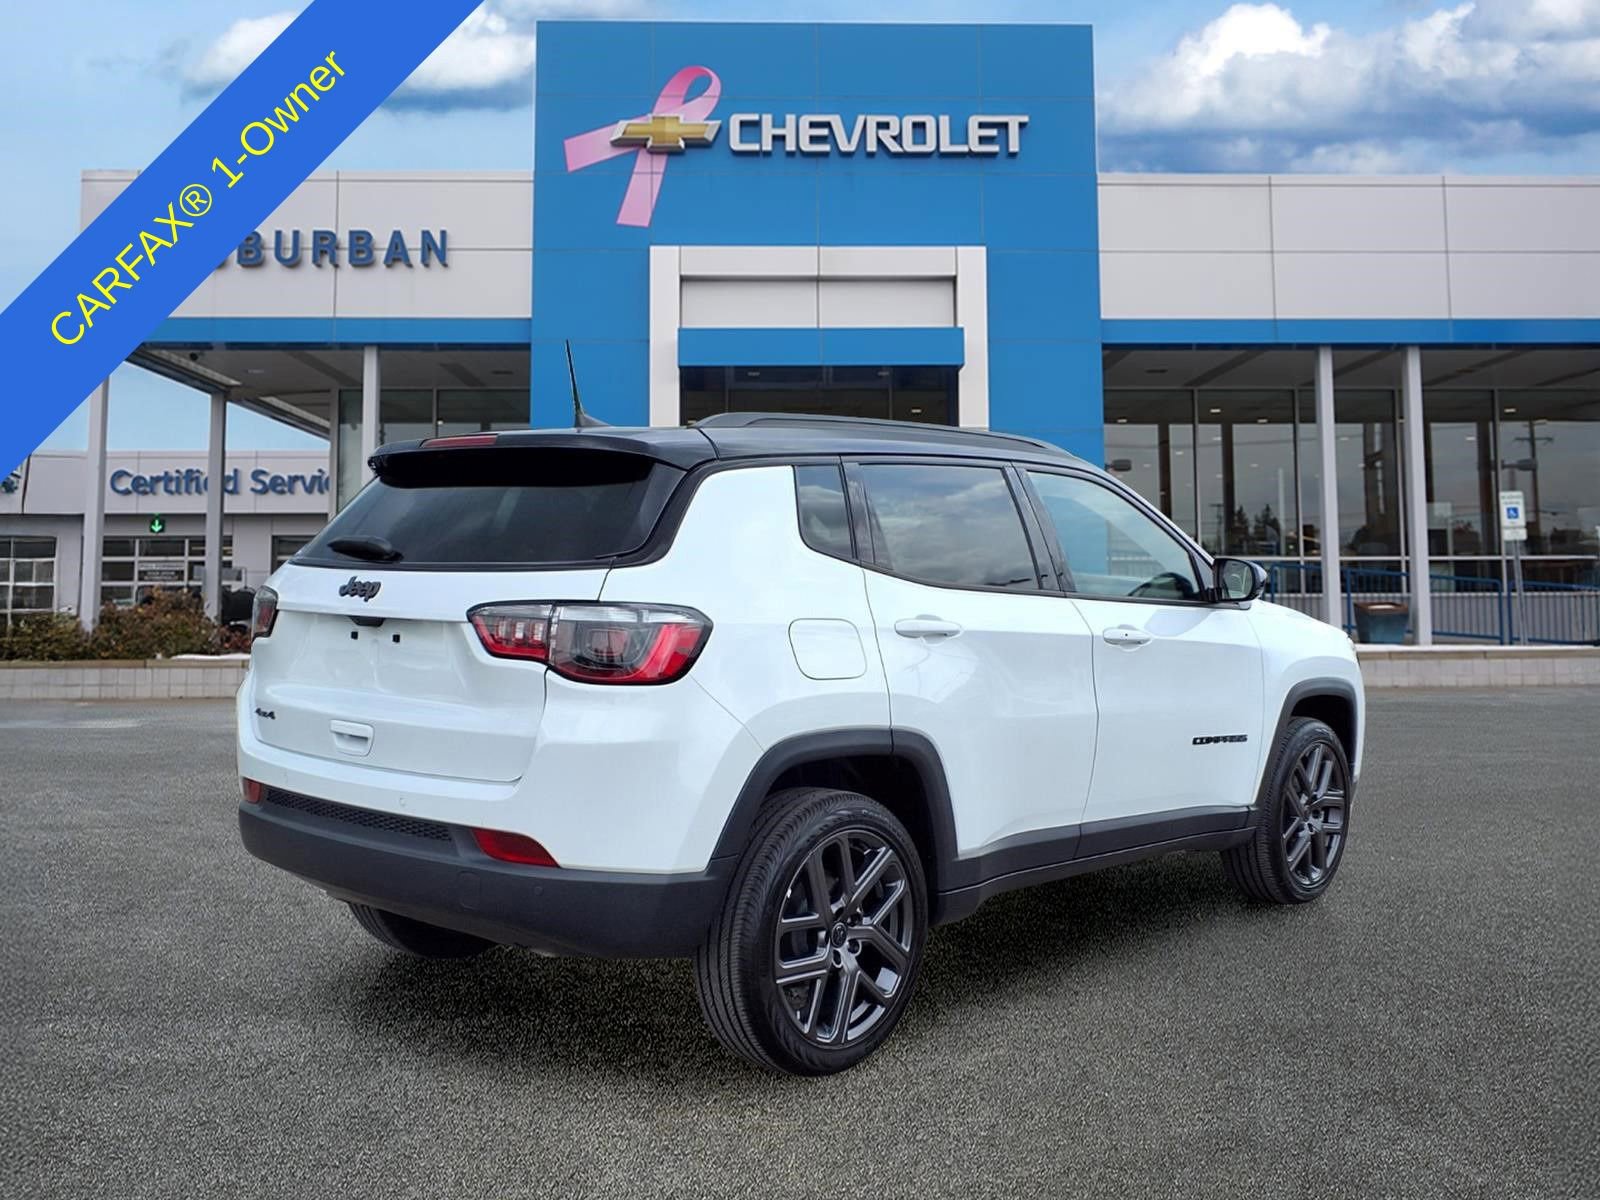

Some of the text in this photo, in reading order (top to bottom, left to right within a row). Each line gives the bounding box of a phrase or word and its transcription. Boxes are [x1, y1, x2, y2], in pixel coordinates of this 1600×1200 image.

[729, 113, 1029, 154] CHEVROLET
[217, 229, 448, 269] BURBAN
[110, 468, 329, 496] Certifid Servi
[339, 576, 381, 602] Jeep
